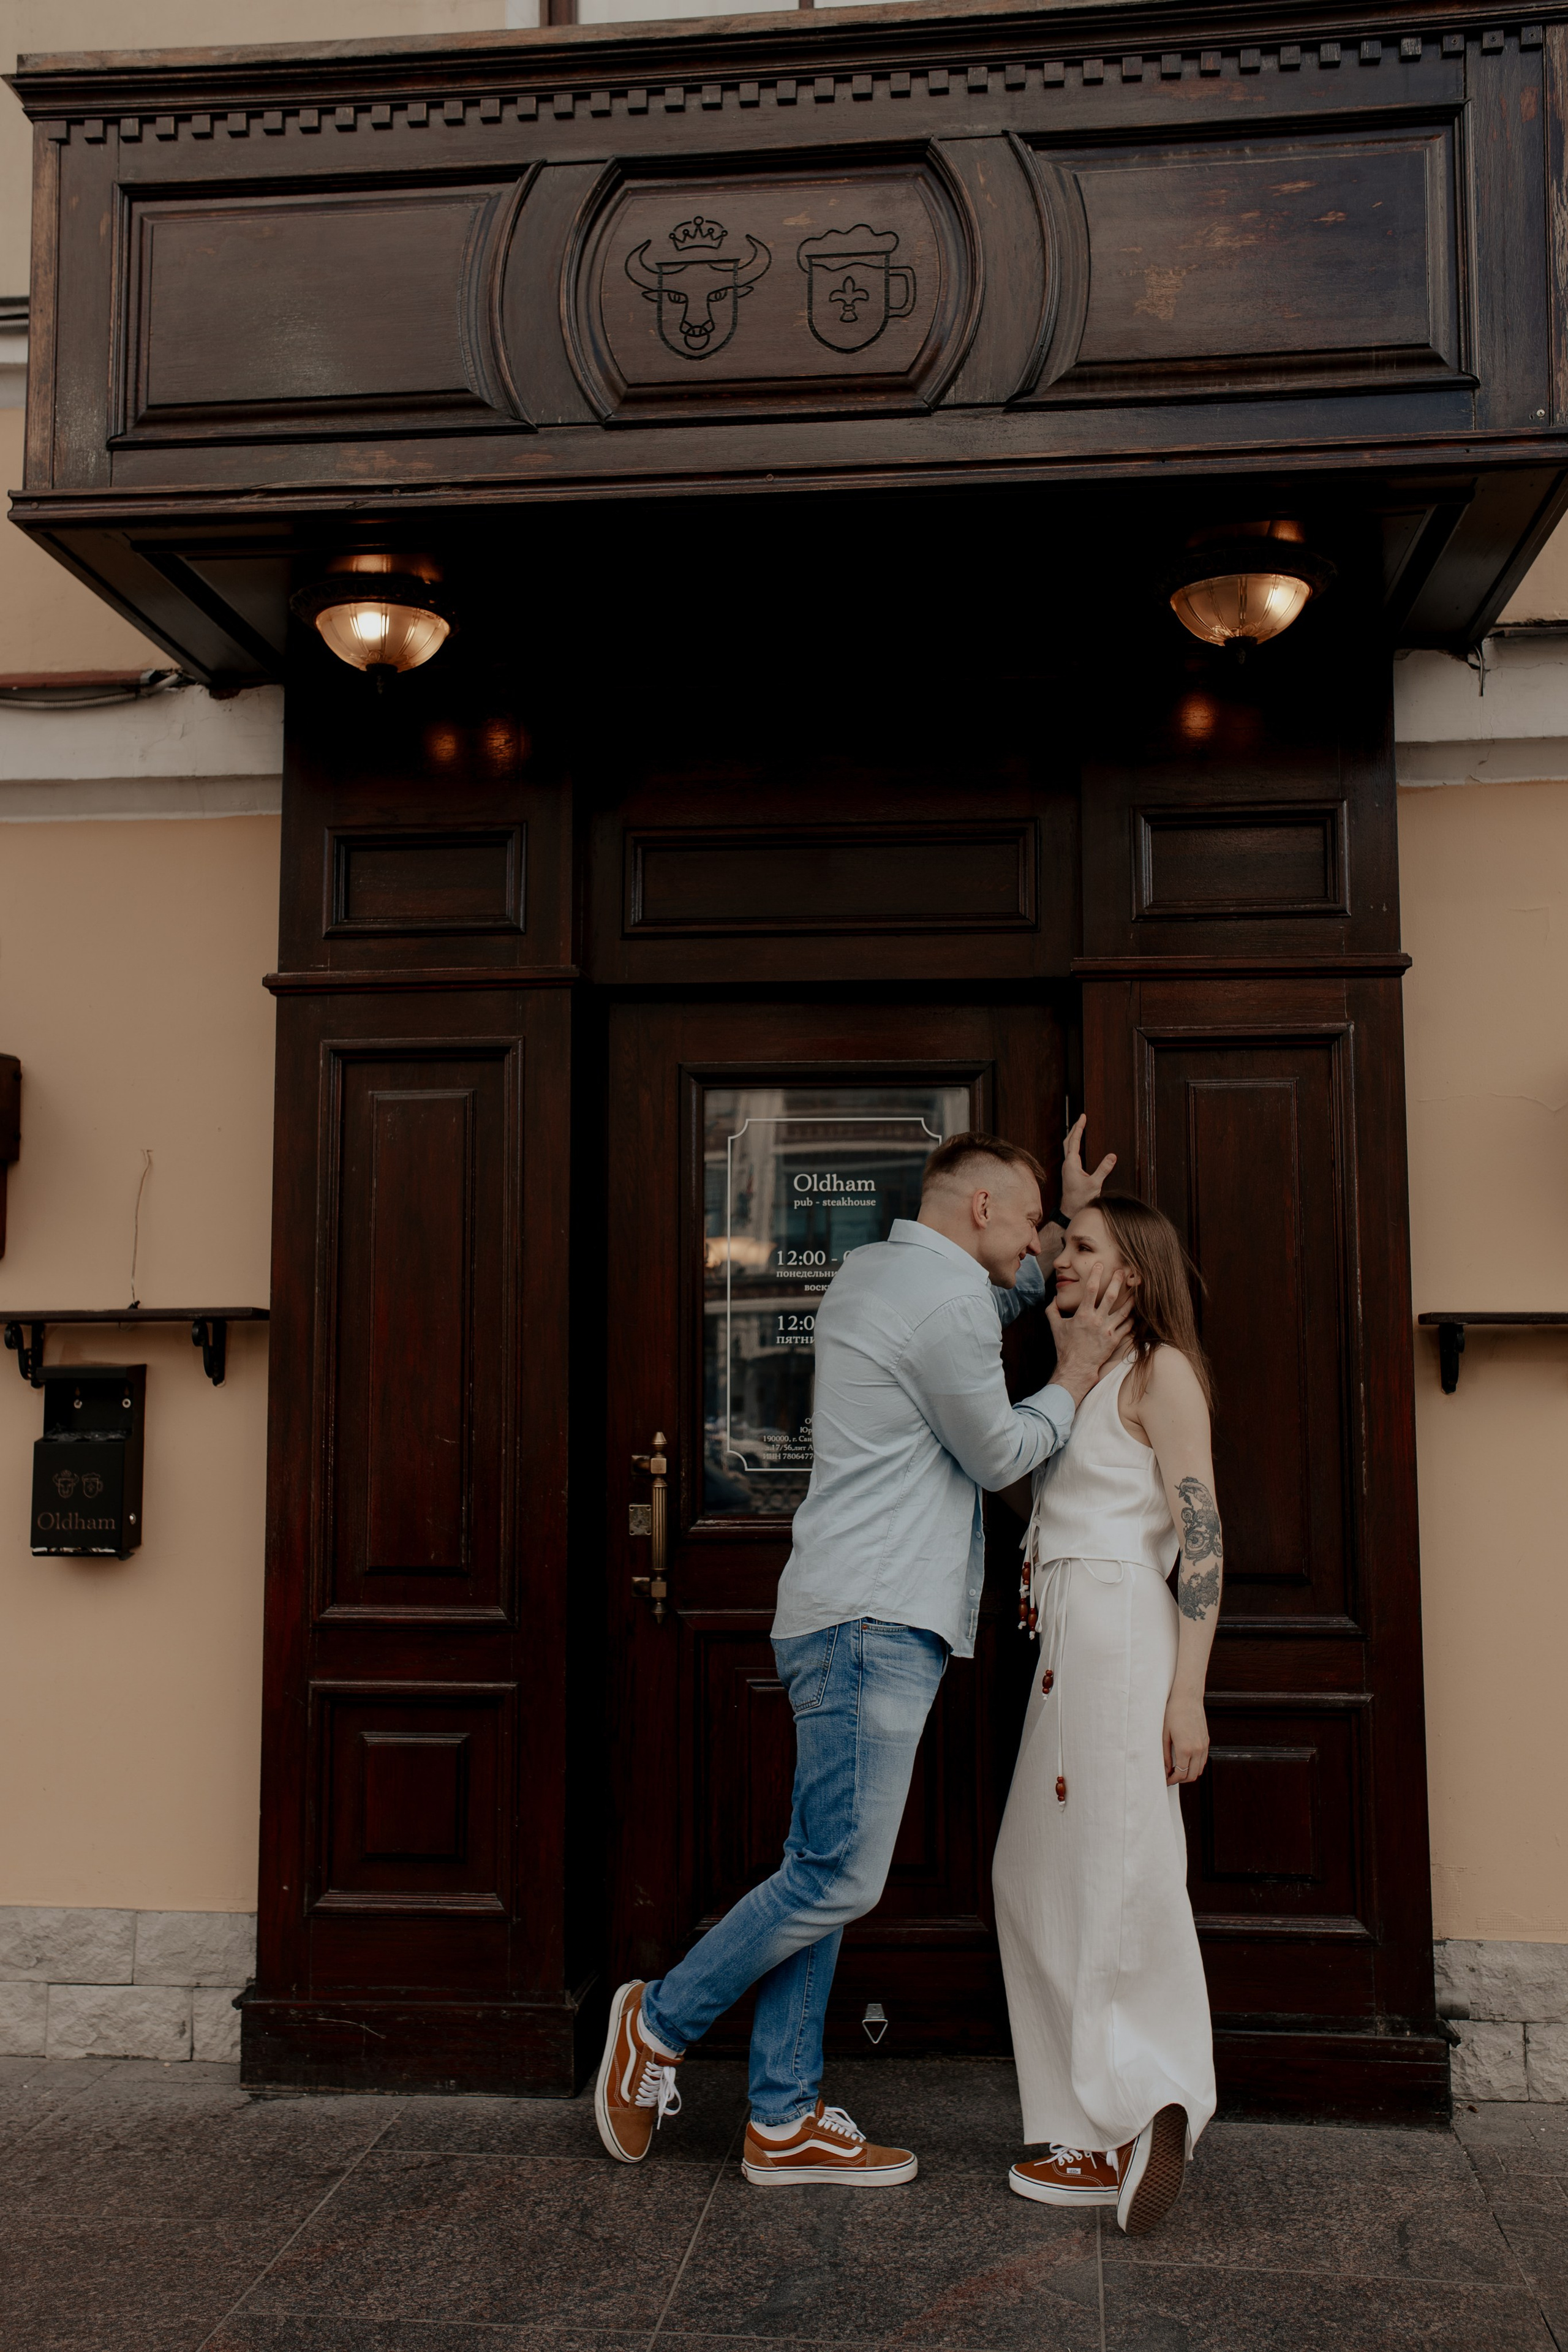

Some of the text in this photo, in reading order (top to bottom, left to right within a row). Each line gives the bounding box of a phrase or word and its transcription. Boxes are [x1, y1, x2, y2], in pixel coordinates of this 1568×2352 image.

[793, 1174, 876, 1192] Oldham
[794, 1197, 813, 1209] pub
[822, 1197, 876, 1207] steakhouse
[777, 1250, 826, 1266] 12:00
[777, 1315, 815, 1330] 12:0
[799, 1427, 813, 1435] Юр
[37, 1512, 116, 1531] Oldham
